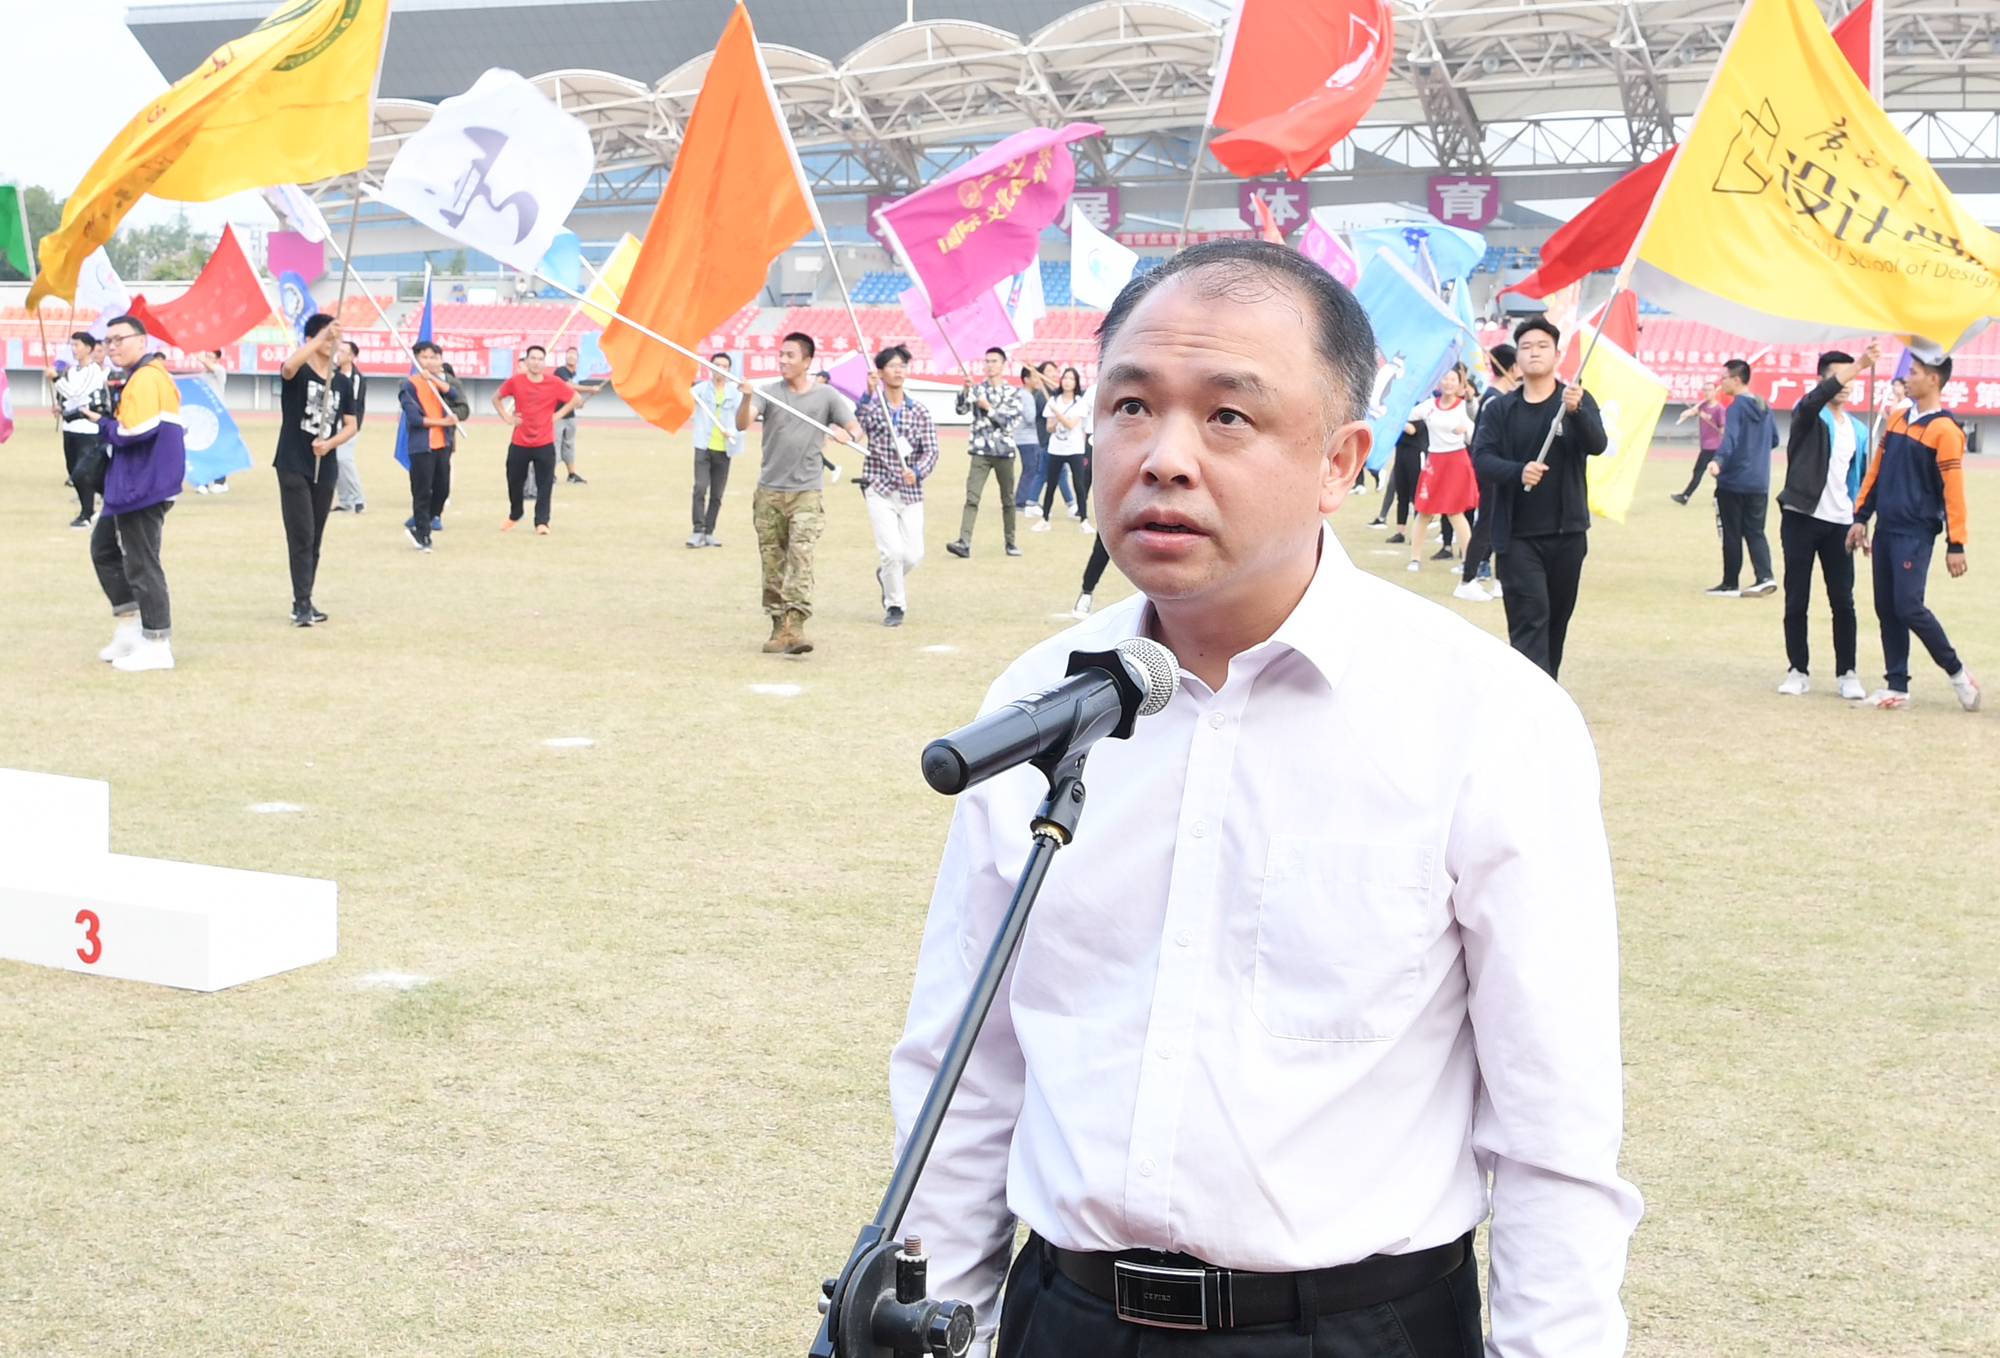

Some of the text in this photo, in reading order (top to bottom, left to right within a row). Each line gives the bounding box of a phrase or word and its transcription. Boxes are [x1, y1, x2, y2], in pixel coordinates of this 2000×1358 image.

[1248, 187, 1300, 226] 体
[1435, 181, 1491, 221] 育
[1779, 148, 1990, 271] 设计学
[1905, 259, 1930, 276] of
[710, 334, 875, 352] 音乐学大本营
[1768, 377, 2000, 410] 广师范学第
[75, 909, 102, 964] 3
